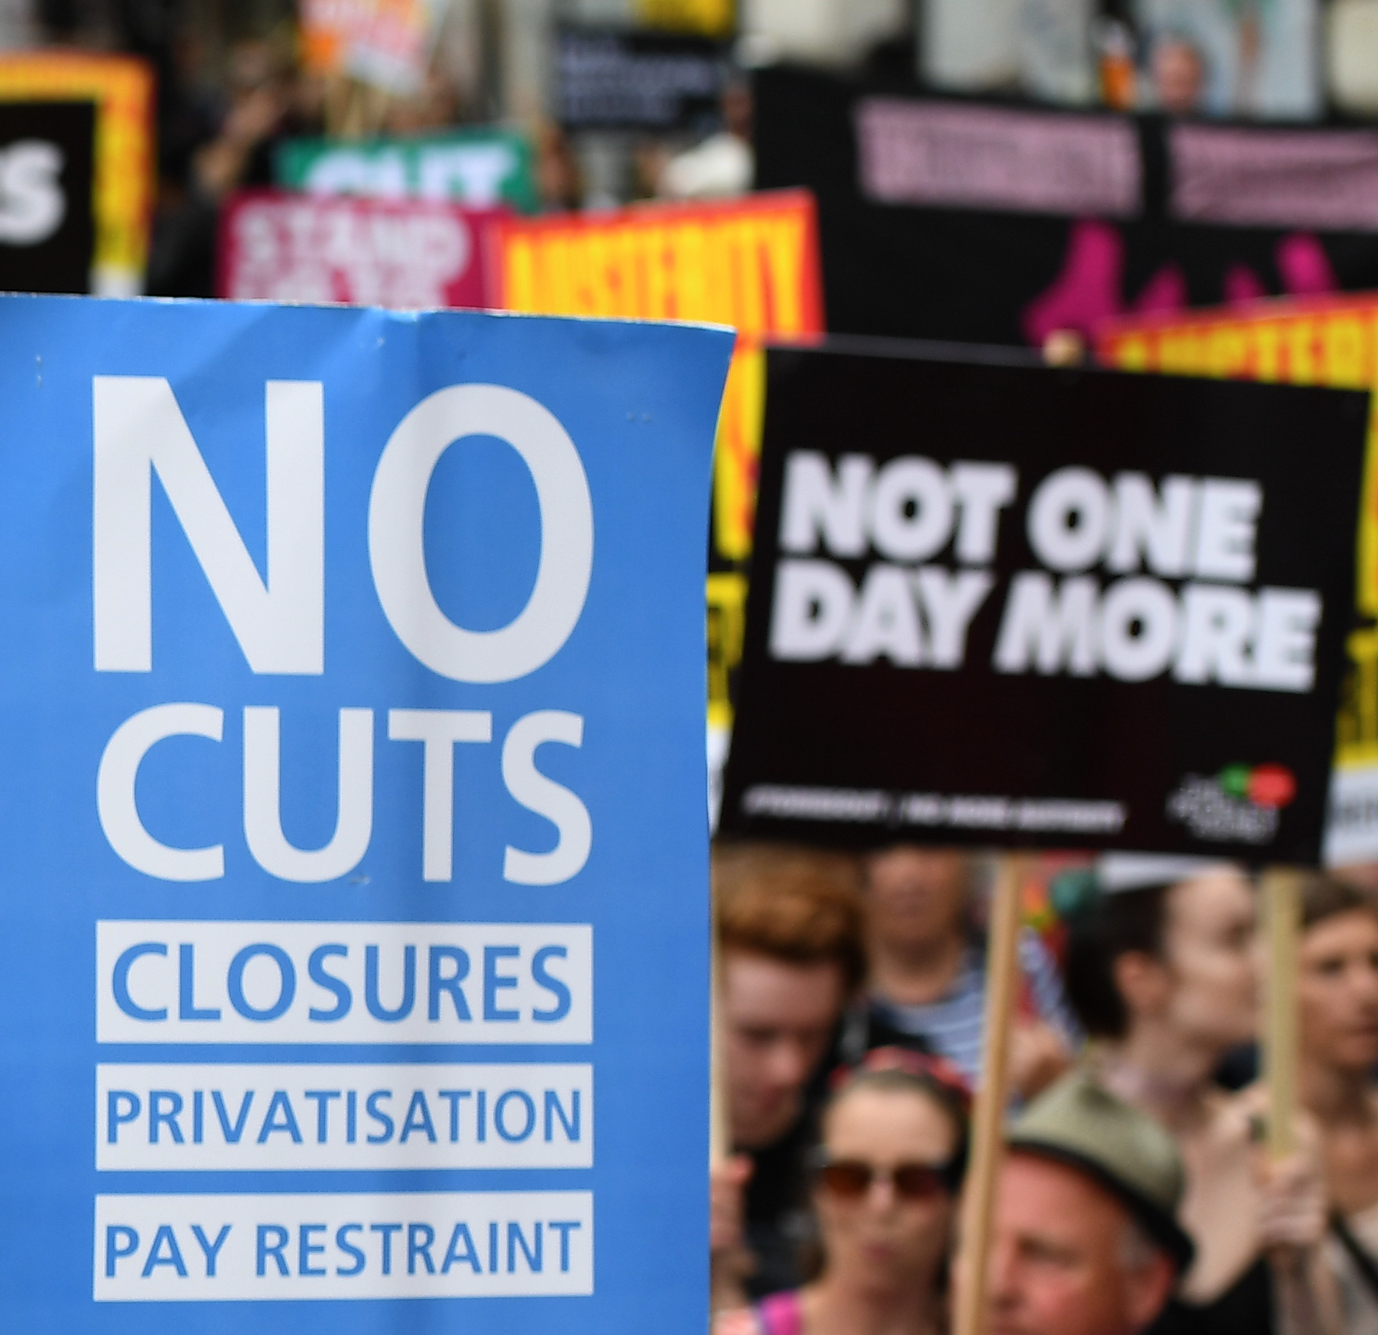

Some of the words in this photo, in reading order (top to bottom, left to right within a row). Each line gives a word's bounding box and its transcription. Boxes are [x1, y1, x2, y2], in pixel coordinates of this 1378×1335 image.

[92, 374, 594, 684] NO
[779, 448, 1018, 563] NOT
[1027, 466, 1262, 582] ONE
[768, 559, 994, 669] DAY
[992, 570, 1322, 693] MORE
[96, 702, 593, 886] CUTS
[110, 942, 572, 1023] CLOSURES
[105, 1088, 582, 1145] PRIVATISATION
[105, 1224, 232, 1278] PAY
[255, 1221, 582, 1276] RESTRAINT
